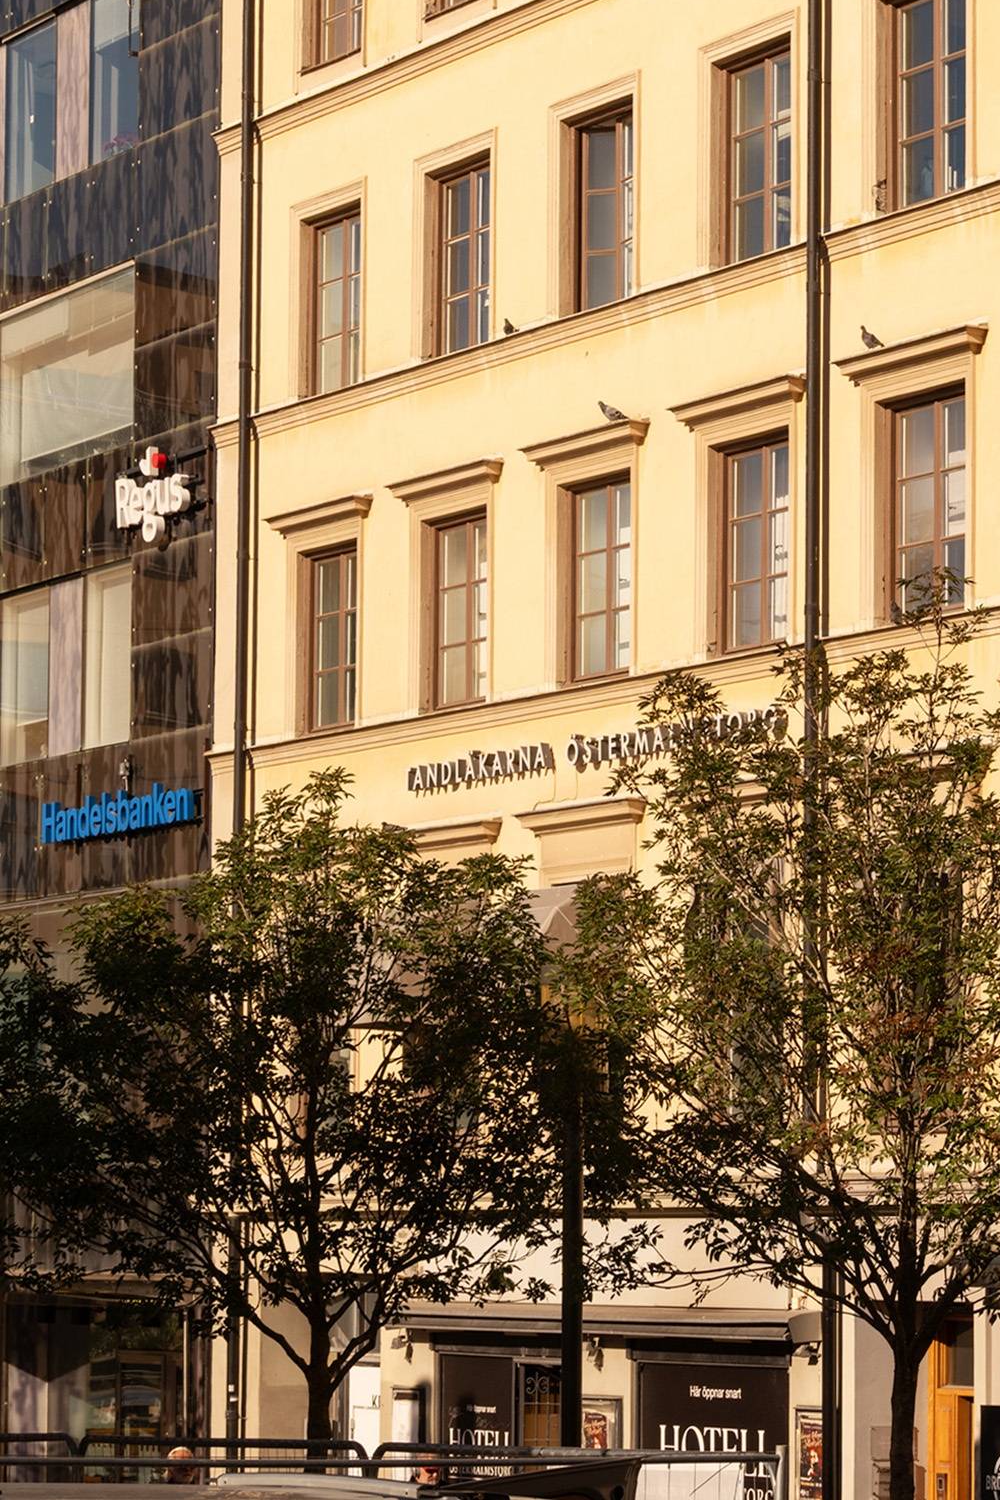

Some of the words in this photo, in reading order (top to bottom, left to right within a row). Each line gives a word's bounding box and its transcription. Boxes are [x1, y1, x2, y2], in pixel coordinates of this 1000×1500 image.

[115, 473, 190, 542] Regus
[567, 707, 783, 765] ÖSTERMALTORG
[41, 782, 195, 844] Handelsbanken
[689, 1385, 701, 1397] Här
[702, 1386, 724, 1401] öppnar
[725, 1388, 742, 1399] snart
